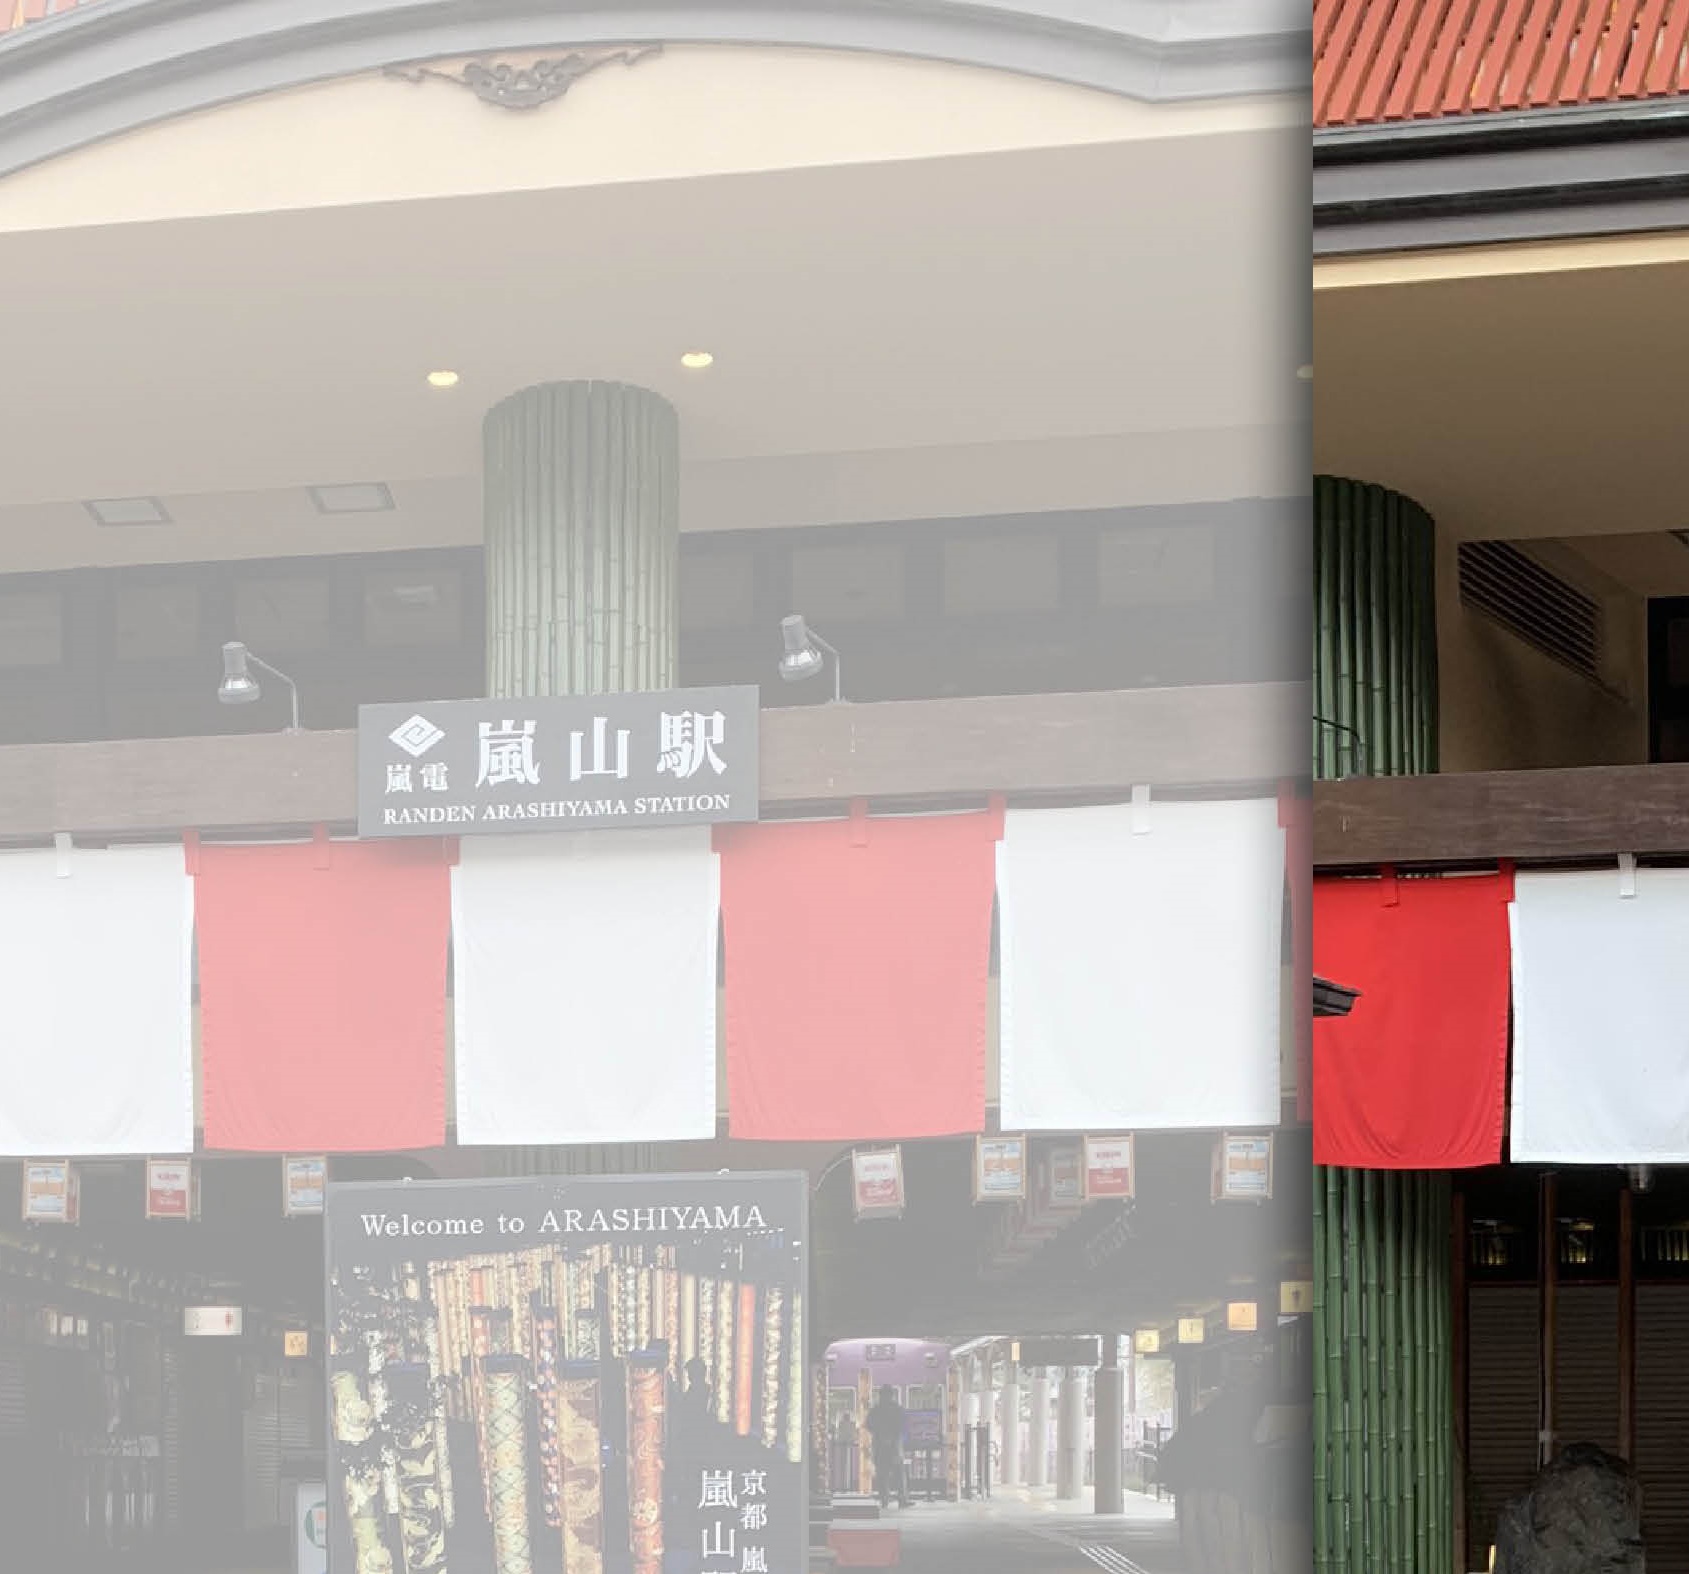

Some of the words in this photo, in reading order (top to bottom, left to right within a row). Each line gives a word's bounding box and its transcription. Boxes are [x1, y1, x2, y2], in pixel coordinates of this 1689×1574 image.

[475, 710, 728, 788] 嵐山駅
[384, 762, 448, 794] 嵐電
[383, 805, 476, 825] RANDEN
[481, 799, 628, 820] ARASHIYAMA
[634, 794, 730, 814] STATION
[359, 1212, 485, 1237] Welcome
[497, 1214, 524, 1235] to
[538, 1205, 767, 1234] ARASHIYAMA
[740, 1469, 768, 1531] 京都
